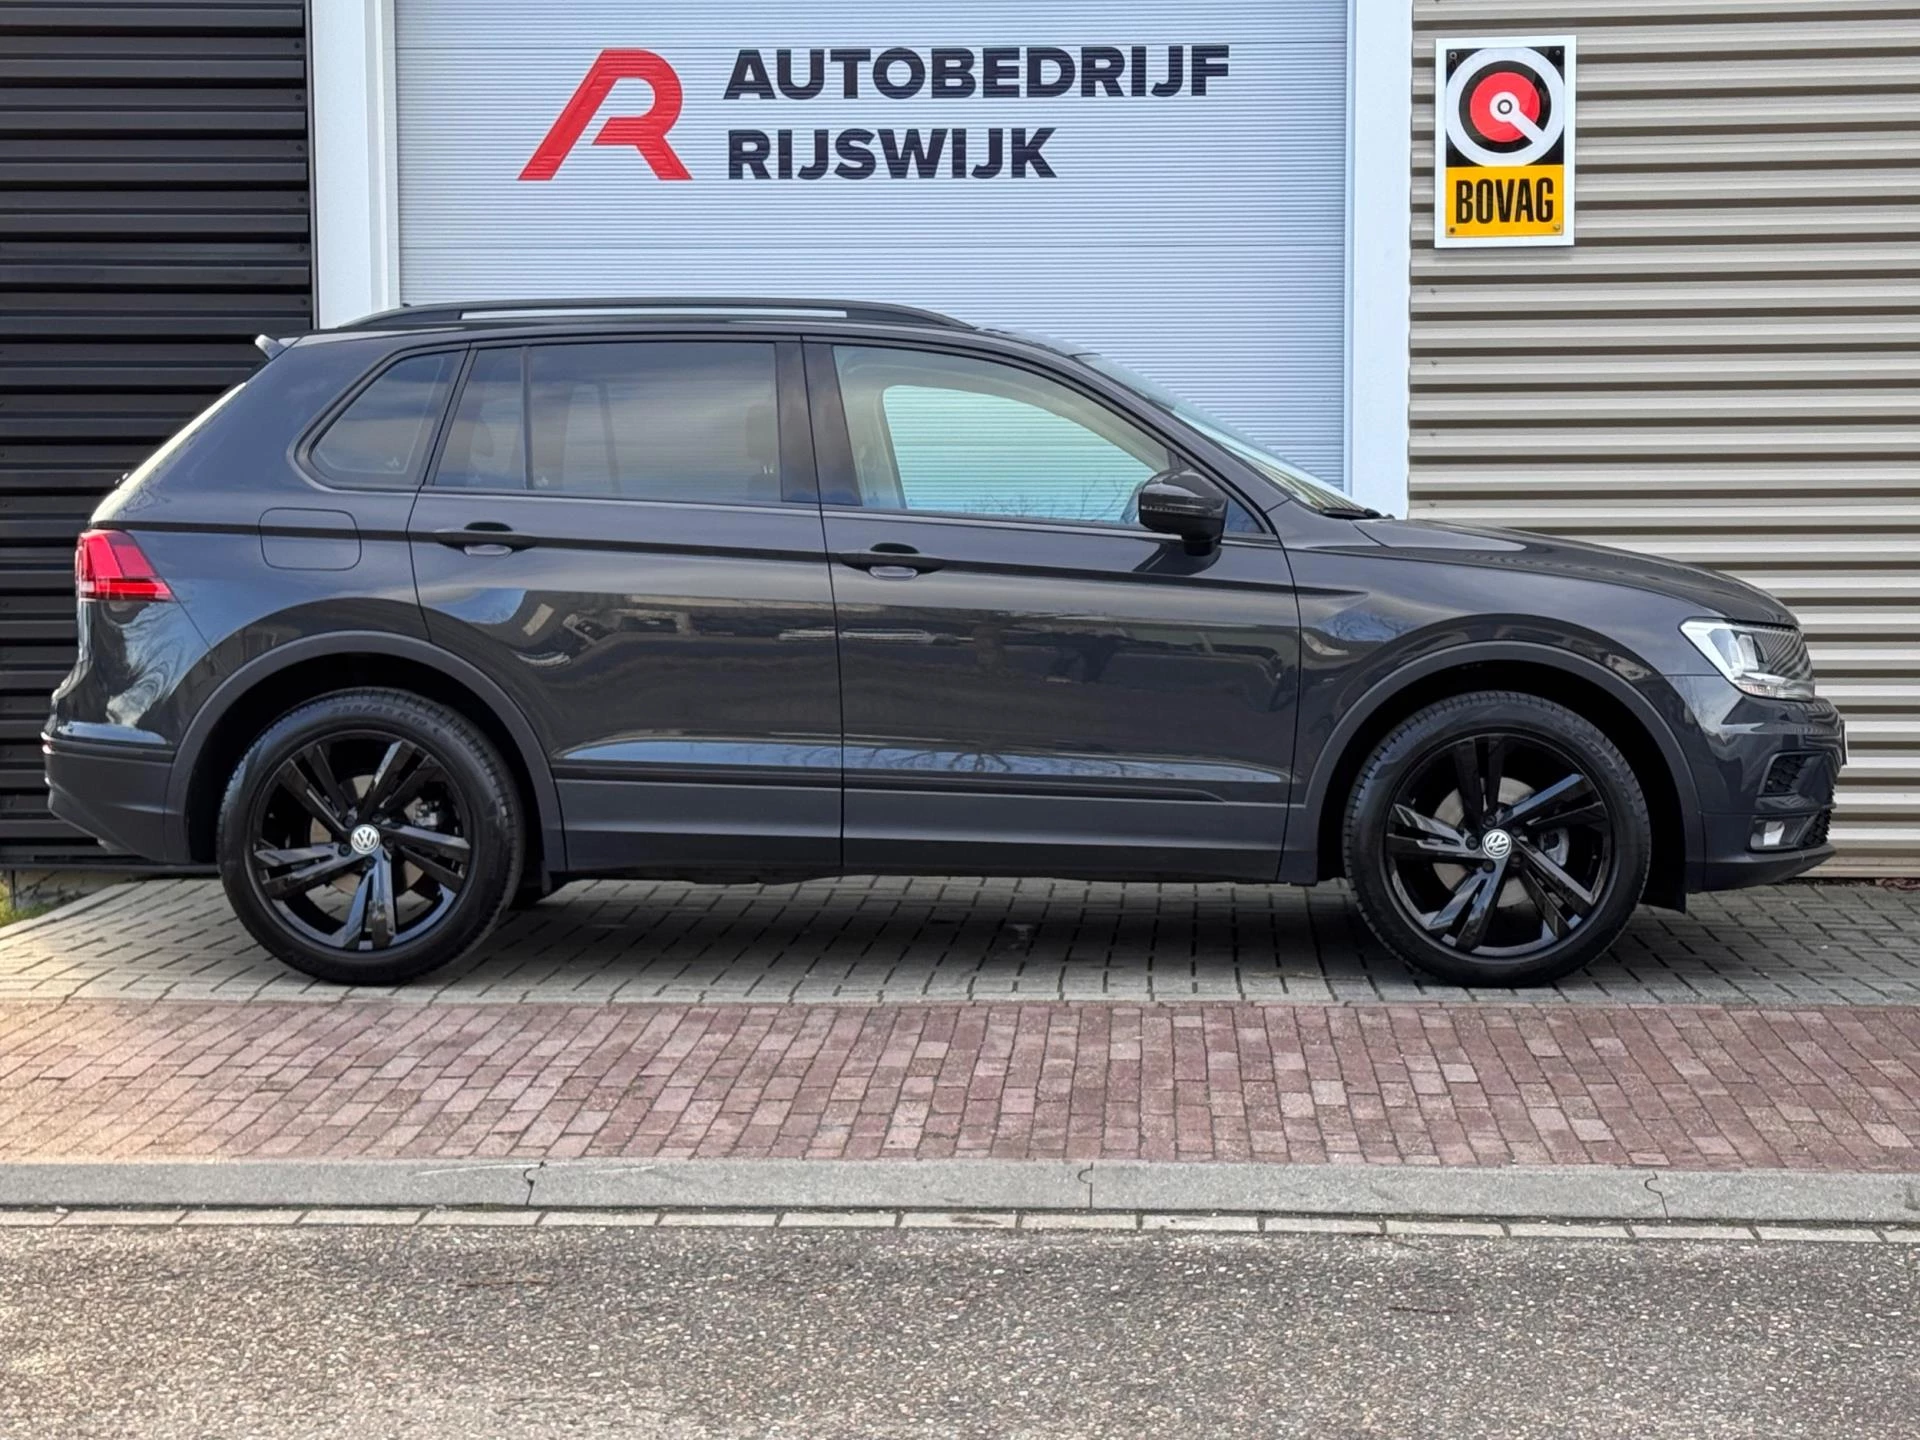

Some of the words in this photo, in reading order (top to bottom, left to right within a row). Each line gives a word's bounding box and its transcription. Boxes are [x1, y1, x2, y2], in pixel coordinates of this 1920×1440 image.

[723, 45, 1229, 100] AUTOBEDRIJF
[727, 127, 1057, 180] RIJSWIJK
[1455, 177, 1554, 224] BOVAG
